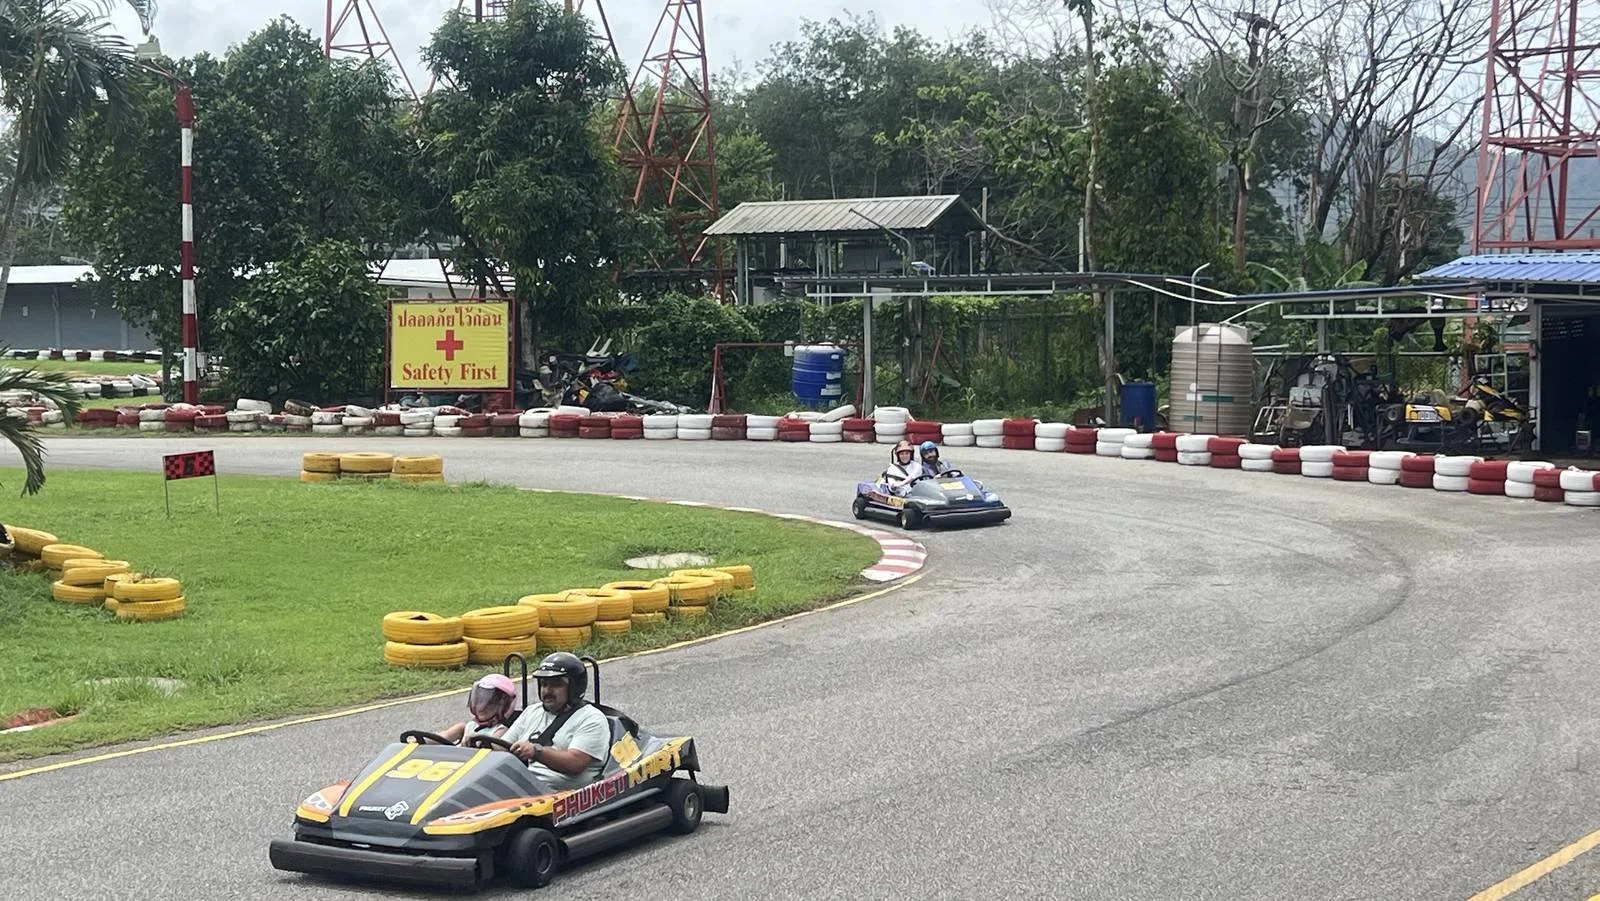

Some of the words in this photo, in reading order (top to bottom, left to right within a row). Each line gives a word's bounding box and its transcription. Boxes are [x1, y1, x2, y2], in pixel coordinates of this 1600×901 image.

[398, 306, 502, 327] ปลอดภัยไว้ก่อน
[402, 363, 452, 385] Safety
[460, 363, 497, 380] First
[385, 759, 465, 782] 96
[552, 769, 628, 828] PHUKET
[627, 746, 682, 788] KART
